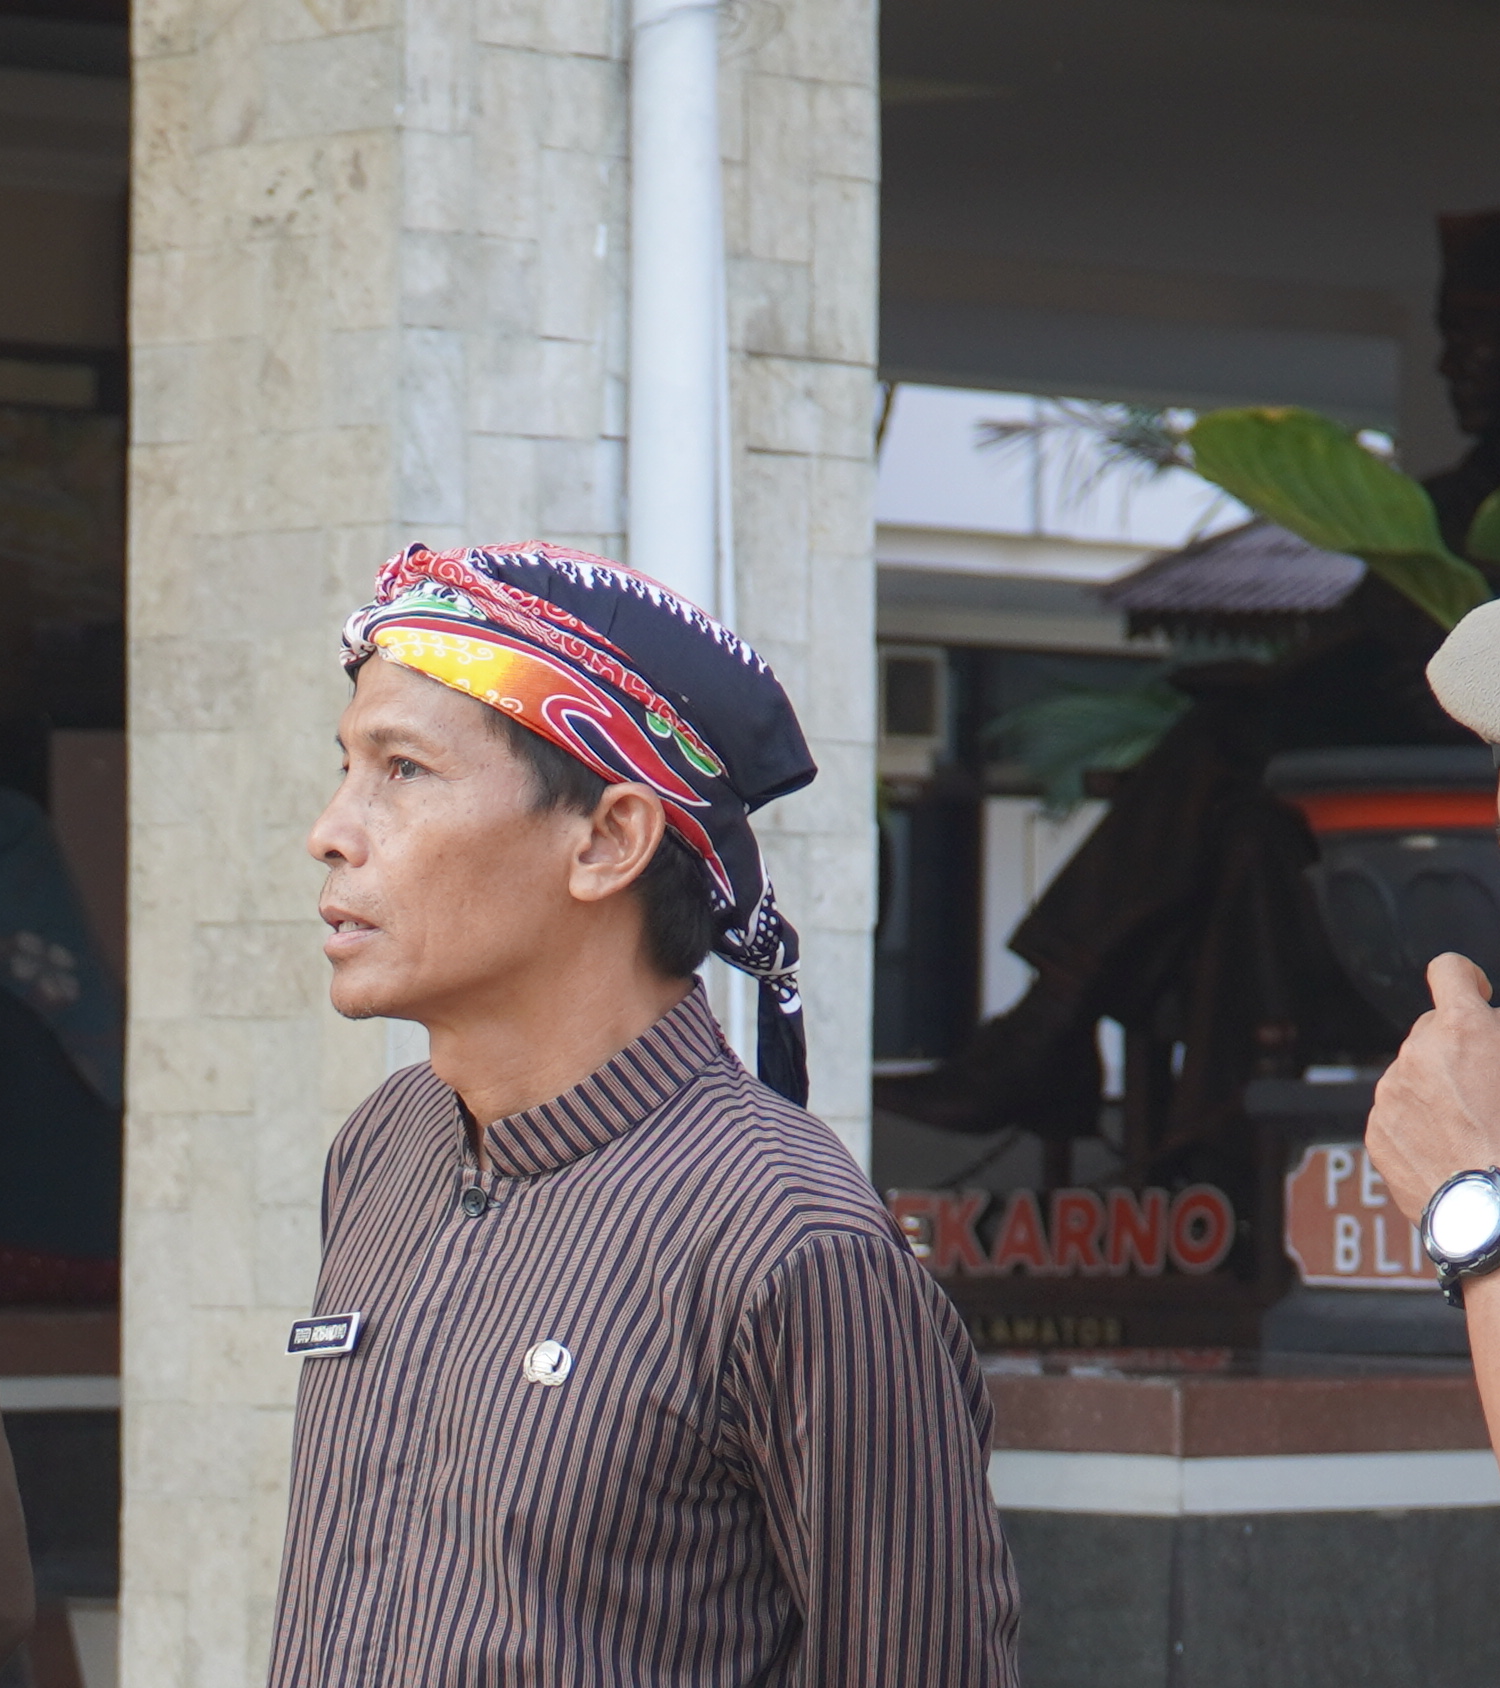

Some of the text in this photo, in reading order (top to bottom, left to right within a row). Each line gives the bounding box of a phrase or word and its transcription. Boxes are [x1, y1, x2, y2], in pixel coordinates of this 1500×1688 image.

[1325, 1150, 1389, 1207] PE
[893, 1184, 1235, 1277] EKARNO
[1334, 1213, 1423, 1274] BLI
